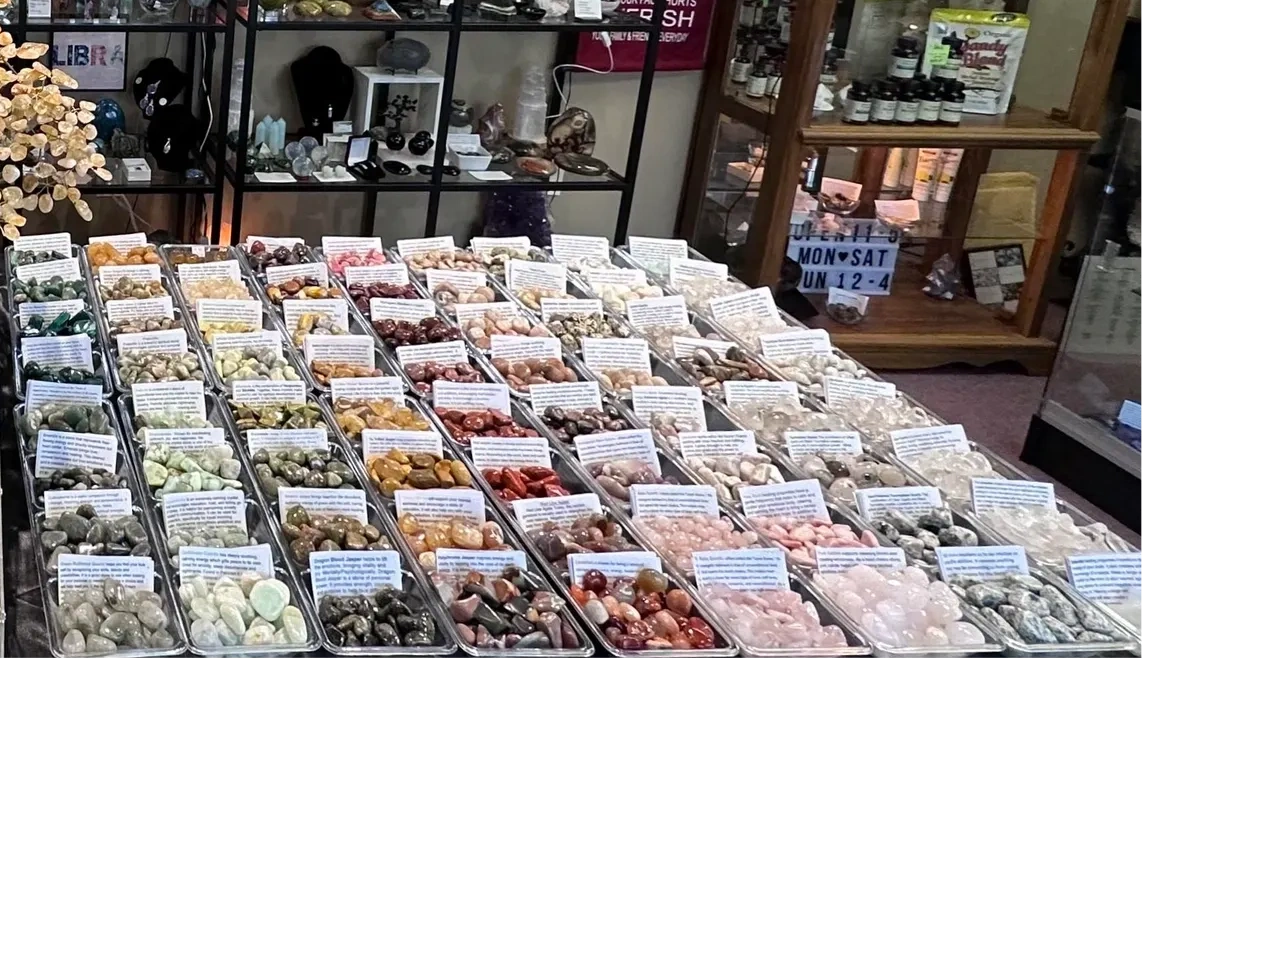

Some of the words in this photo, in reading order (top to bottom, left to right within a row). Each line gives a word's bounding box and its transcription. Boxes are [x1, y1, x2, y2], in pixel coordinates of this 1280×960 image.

[52, 44, 124, 66] LIBRA
[797, 247, 837, 266] MON
[850, 249, 889, 267] SAT
[803, 271, 827, 289] UN
